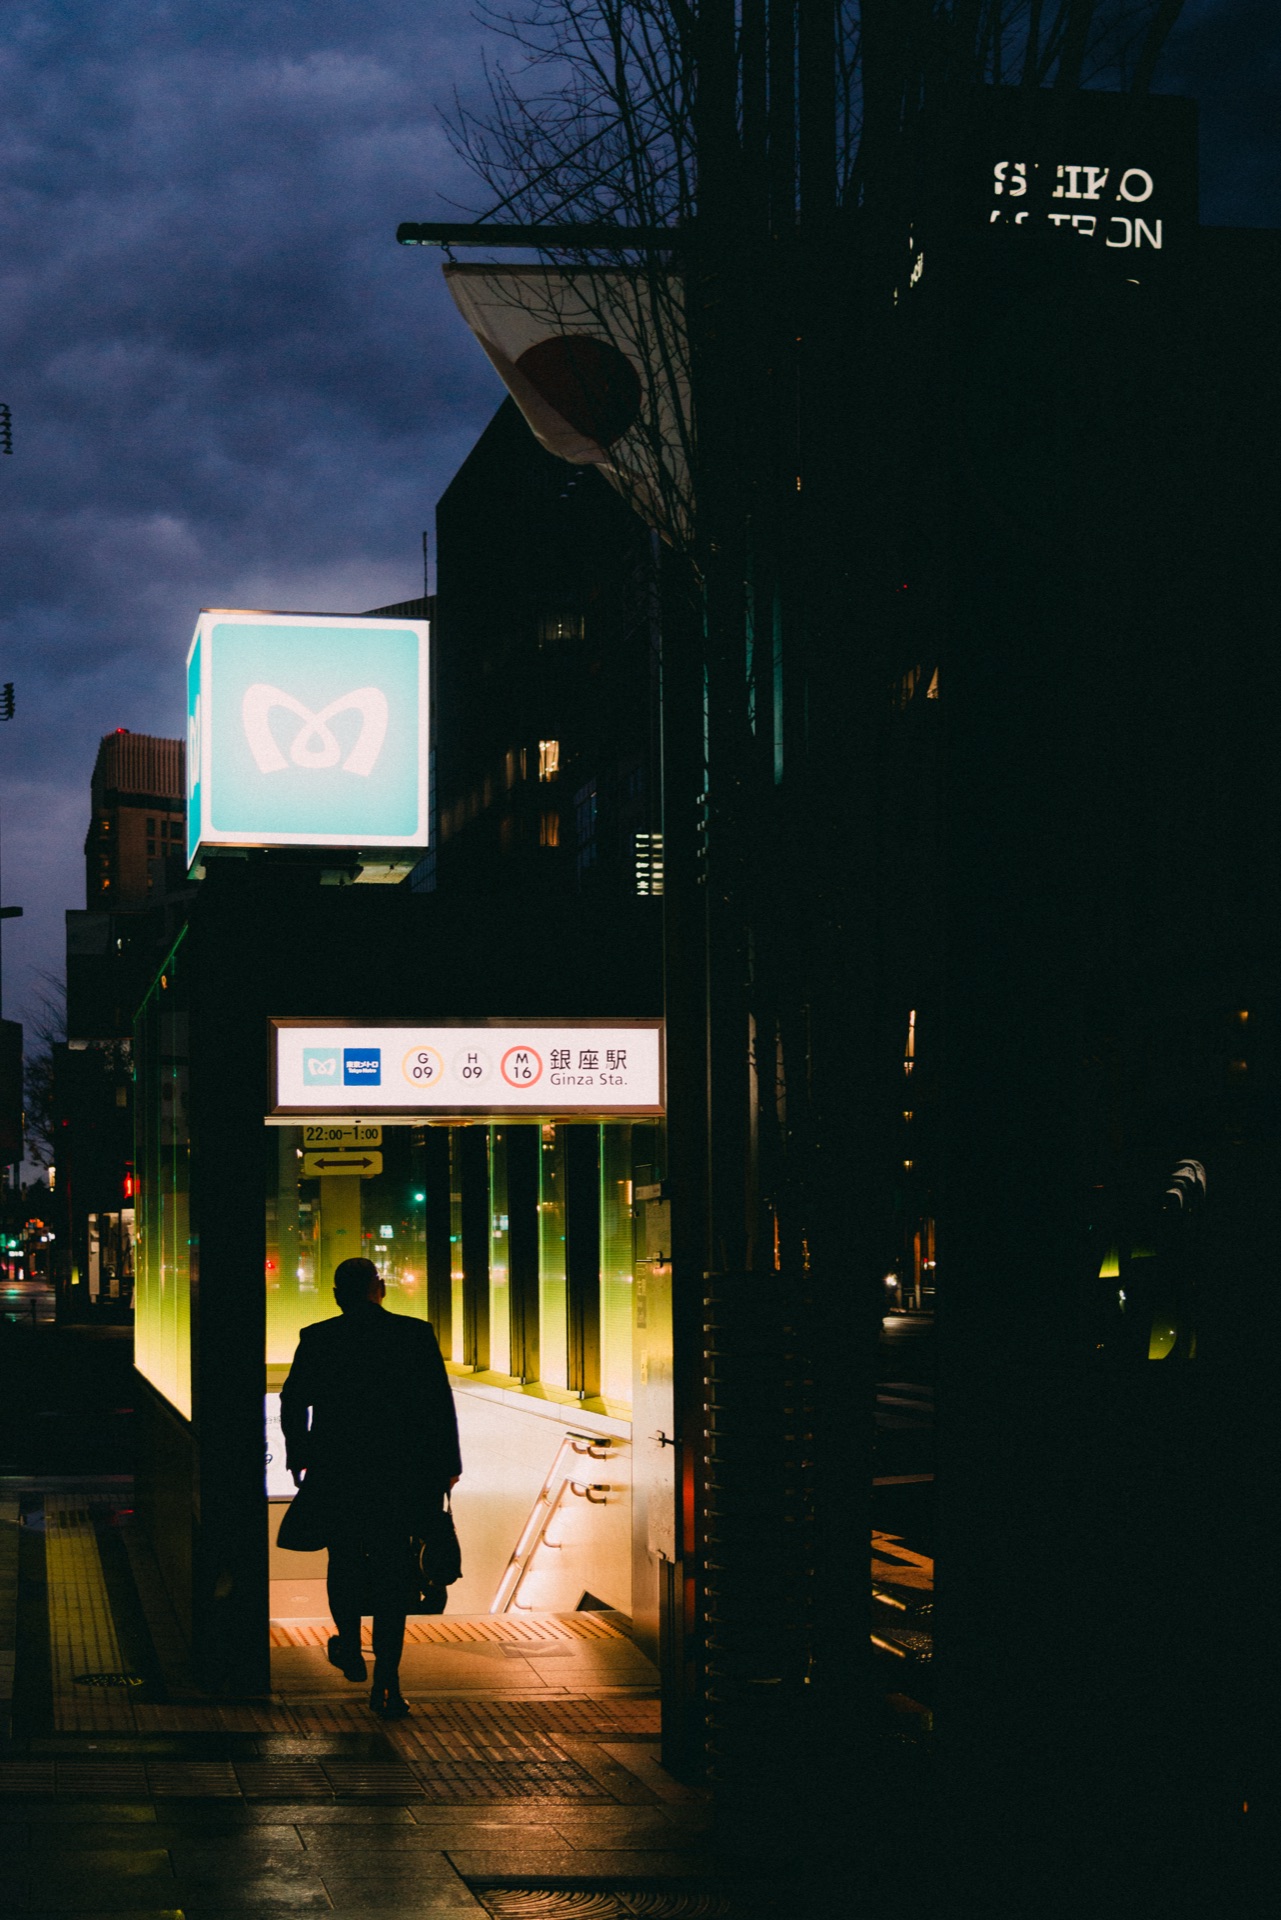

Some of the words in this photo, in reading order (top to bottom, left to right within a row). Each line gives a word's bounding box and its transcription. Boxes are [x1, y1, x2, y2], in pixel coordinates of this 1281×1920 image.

[417, 1052, 429, 1064] G
[467, 1052, 478, 1064] H
[515, 1052, 529, 1064] M
[550, 1049, 628, 1071] 銀座駅
[412, 1066, 434, 1079] 09
[462, 1066, 483, 1079] 09
[513, 1066, 532, 1079] 16
[550, 1073, 594, 1086] Ginza
[599, 1073, 628, 1086] Sta.
